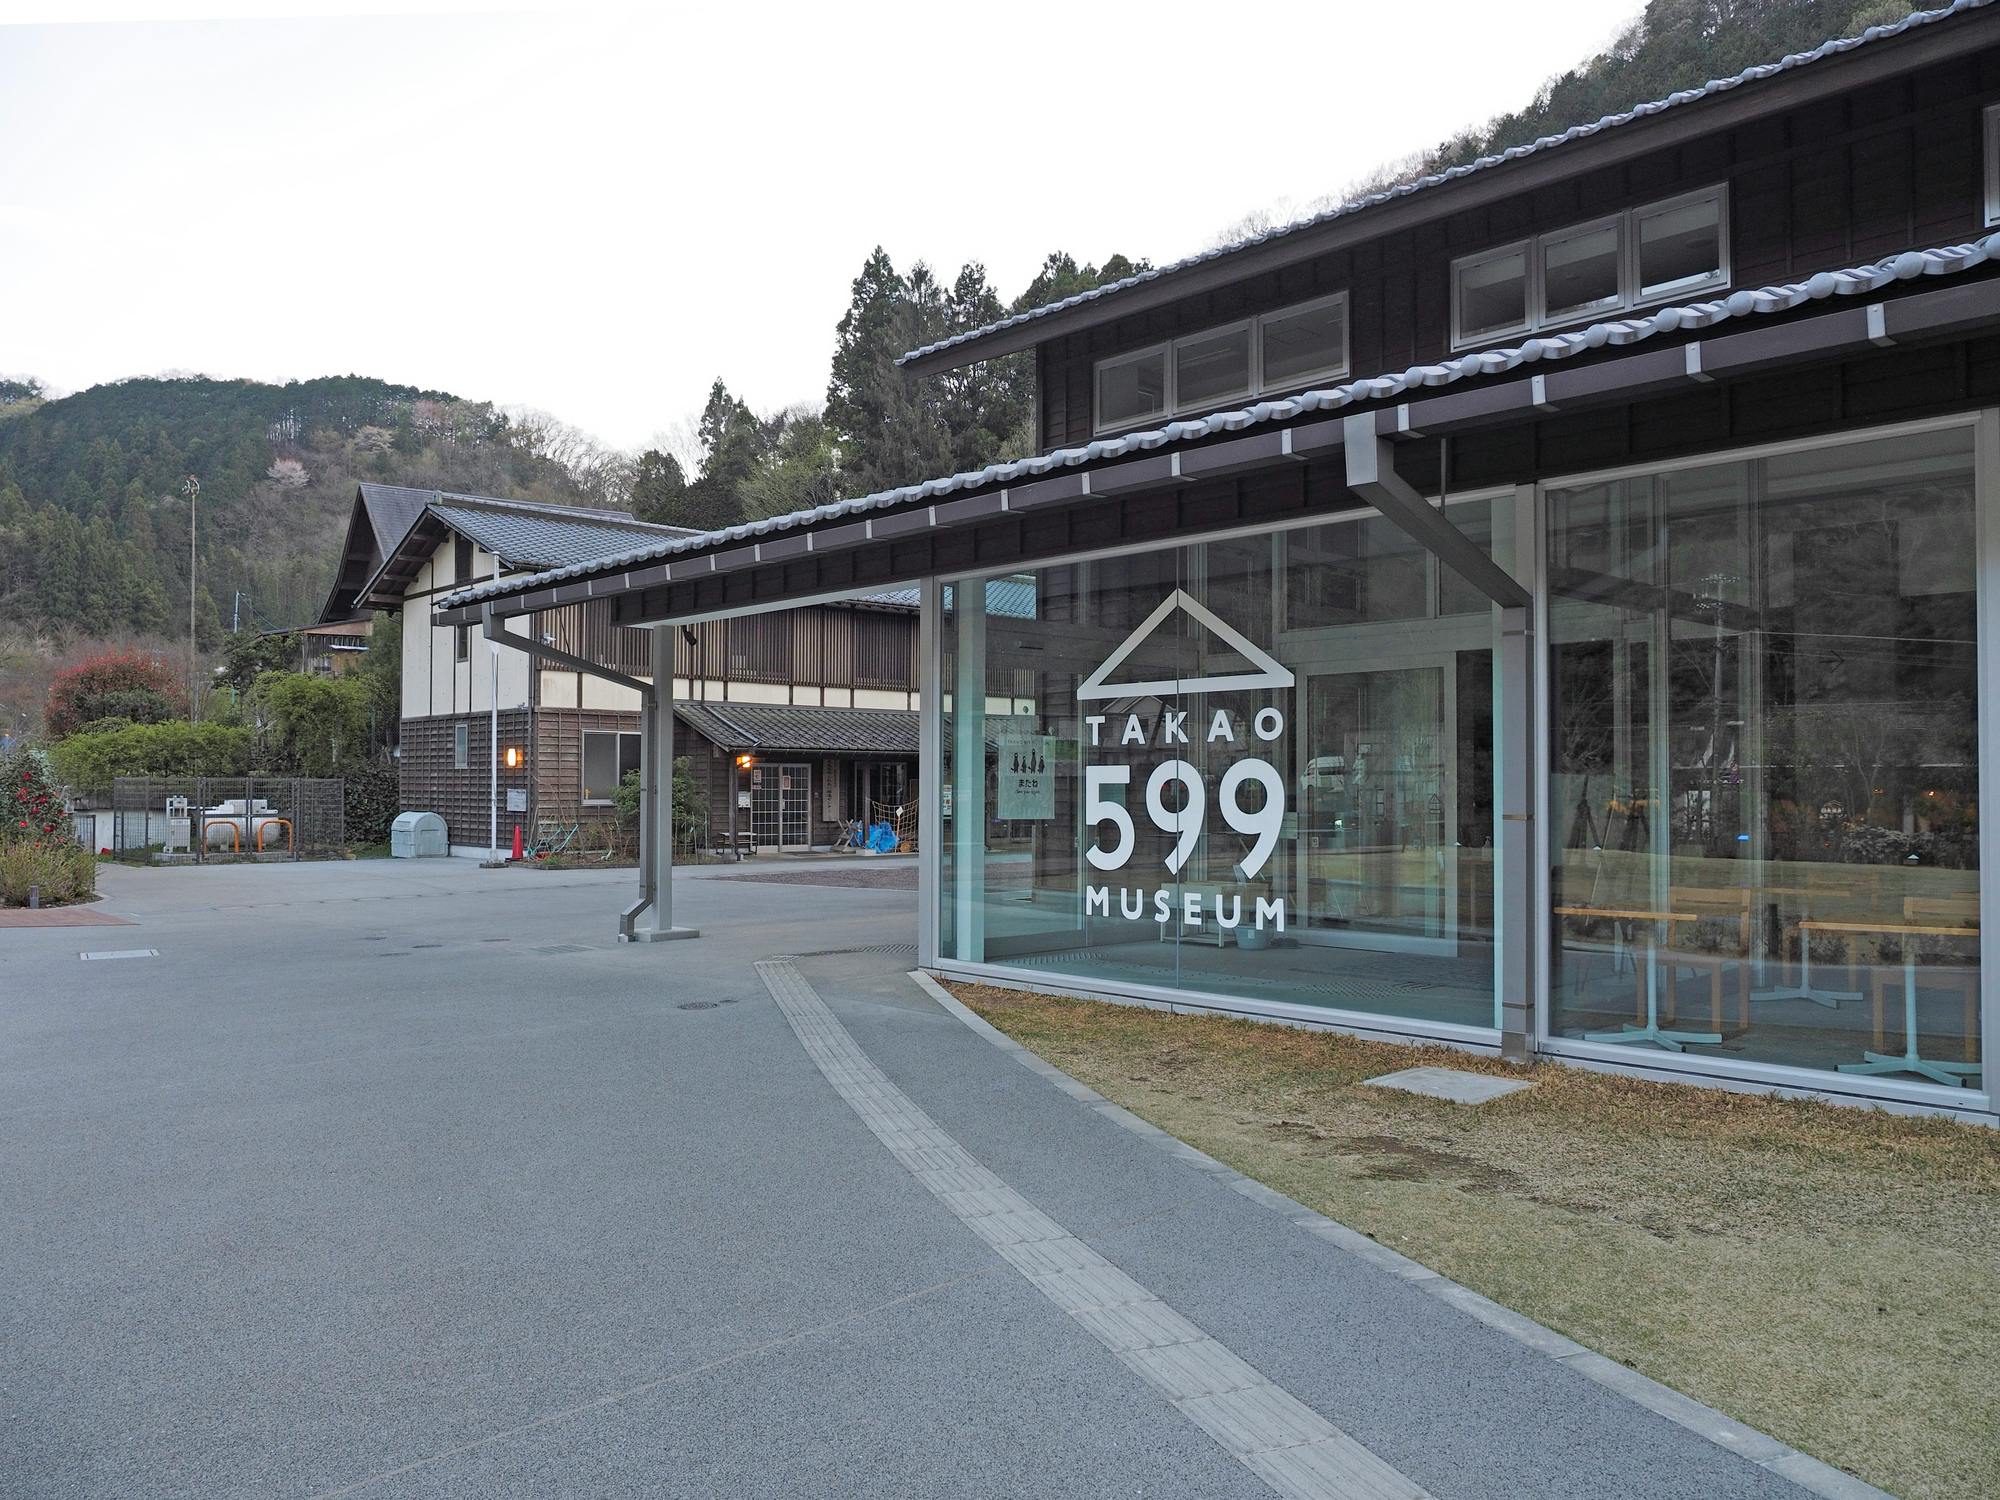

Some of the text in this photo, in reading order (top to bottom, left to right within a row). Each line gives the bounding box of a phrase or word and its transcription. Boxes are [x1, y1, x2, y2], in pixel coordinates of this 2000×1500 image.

[1085, 707, 1284, 746] TAKAO
[1085, 758, 1285, 880] 599
[1085, 885, 1285, 933] MUSEUM
